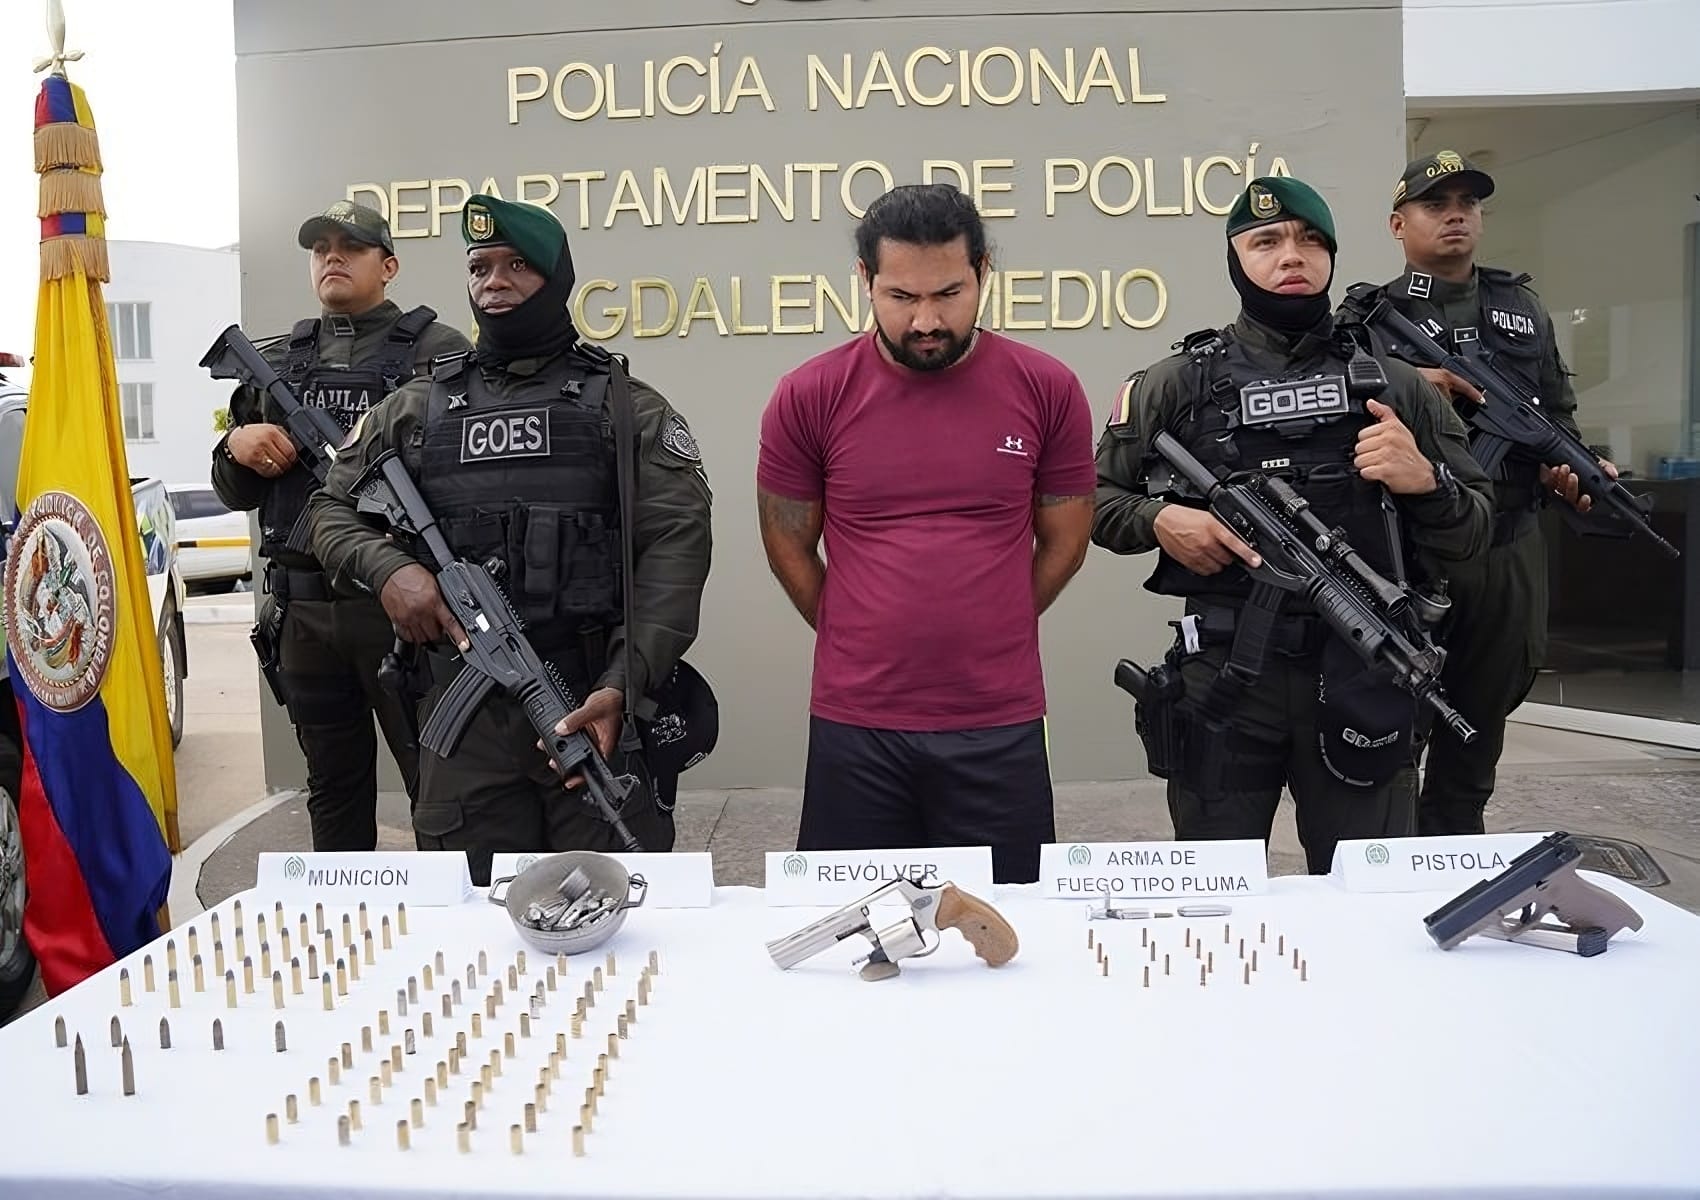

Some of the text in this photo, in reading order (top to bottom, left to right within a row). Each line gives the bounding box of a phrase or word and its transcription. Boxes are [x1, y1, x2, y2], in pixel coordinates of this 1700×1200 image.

[508, 42, 1167, 124] POLICÍA NACIONAL
[303, 389, 370, 412] GAULA
[1248, 383, 1341, 417] GOES
[468, 416, 543, 456] GOES
[1107, 850, 1197, 866] ARMA DE
[1411, 851, 1506, 872] PISTOLA
[308, 866, 409, 887] MUNICIÓN
[817, 859, 939, 883] REVÓLVER
[1057, 876, 1249, 893] FUEGO TIPO PLUMA
